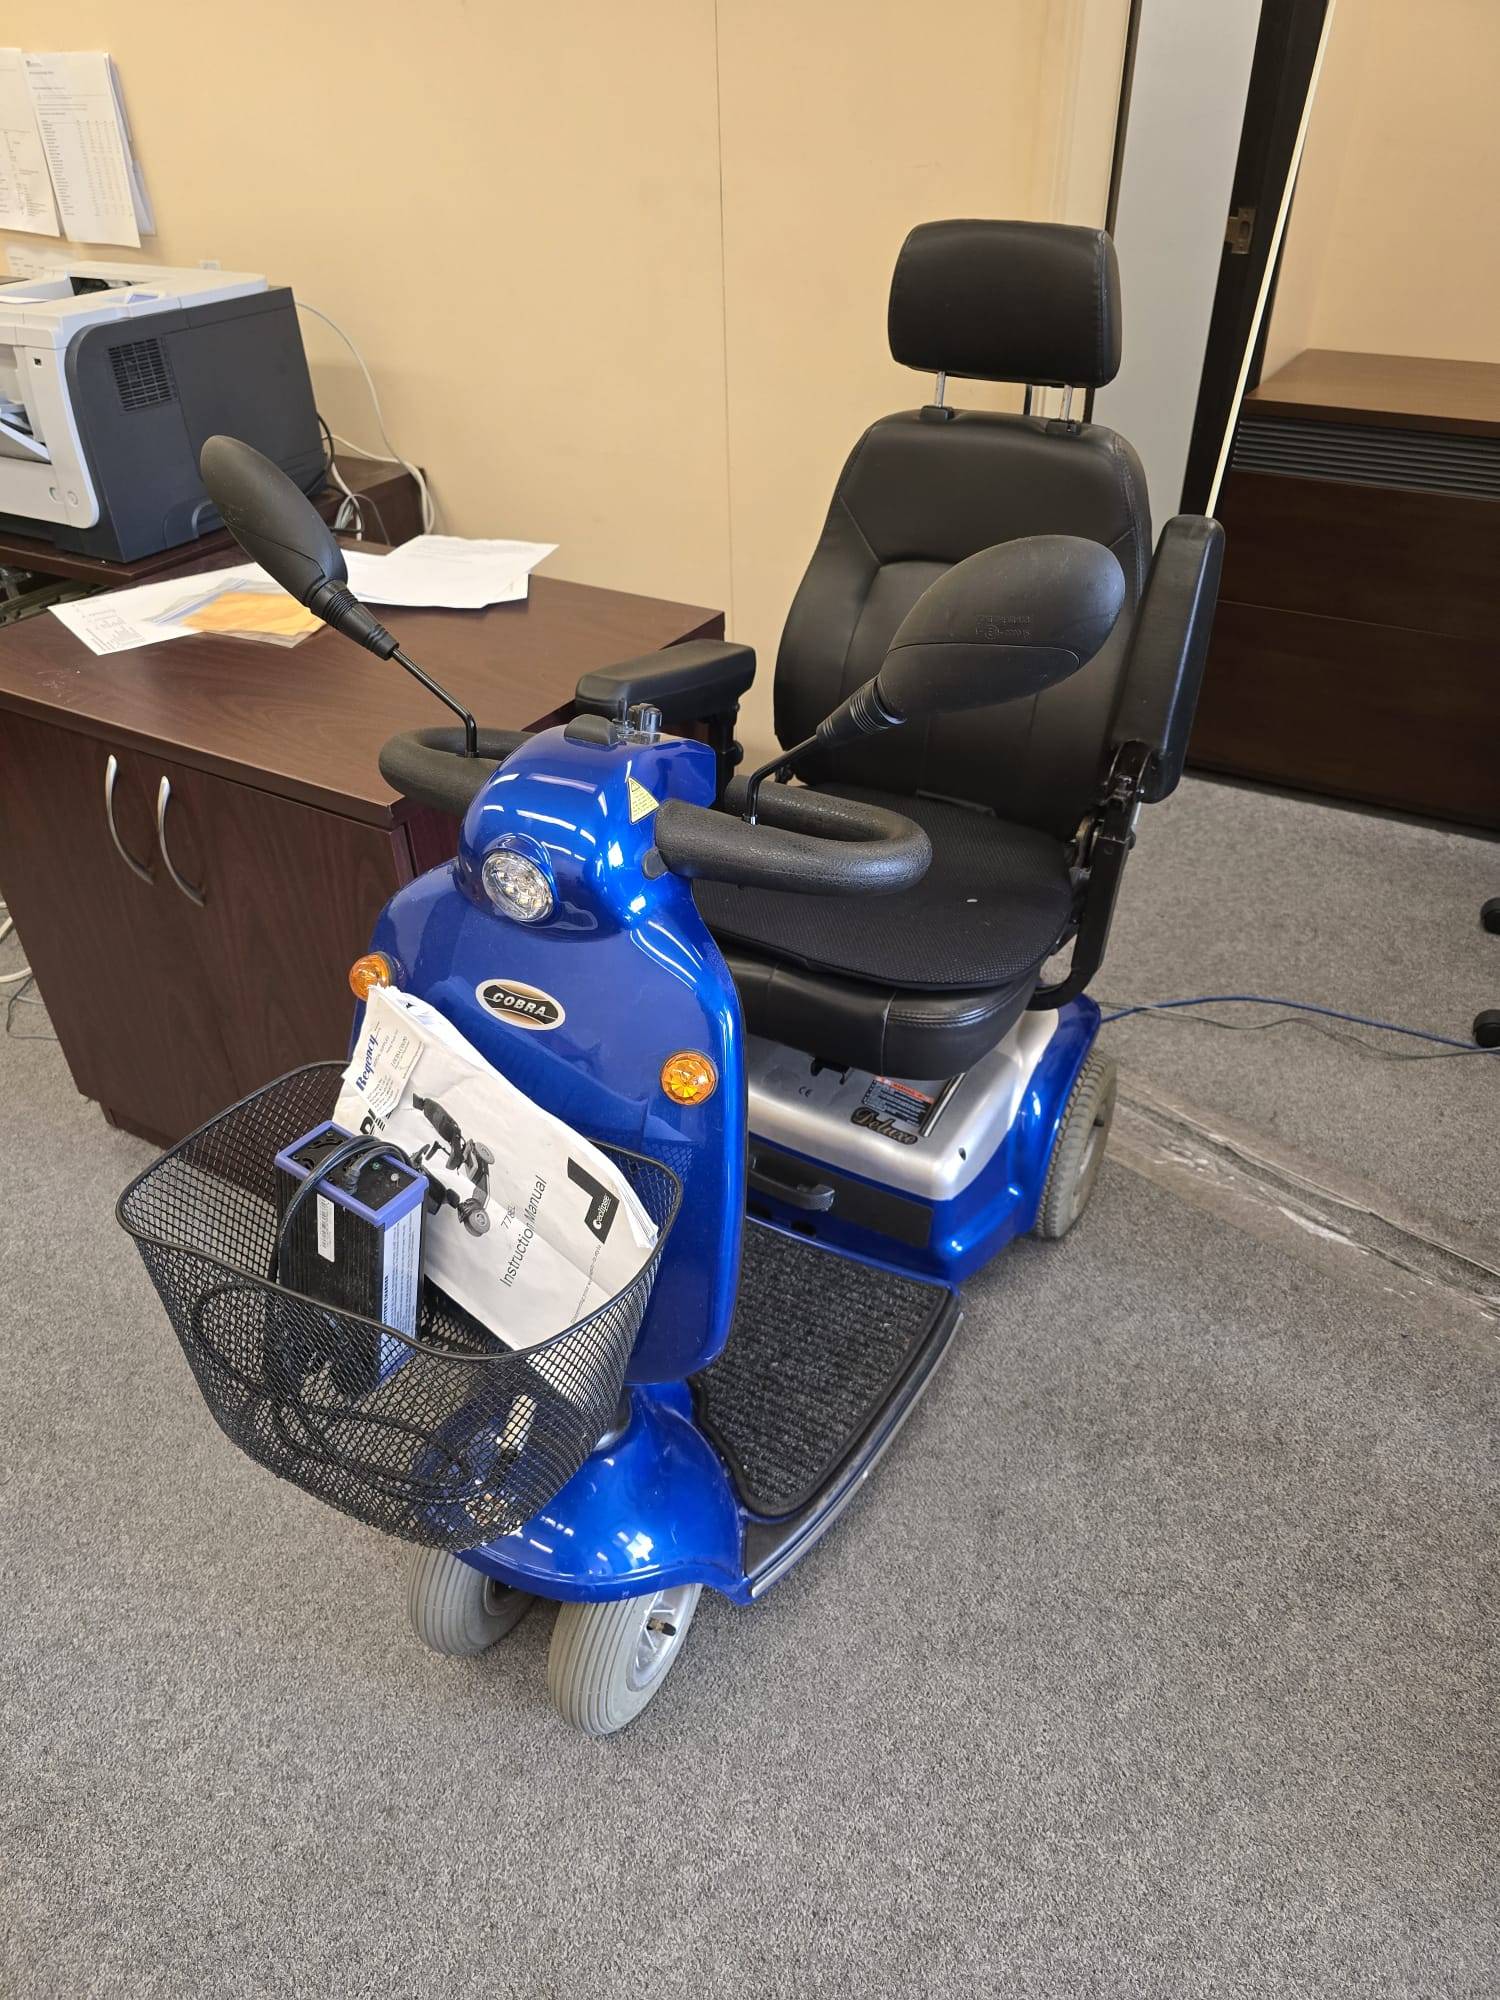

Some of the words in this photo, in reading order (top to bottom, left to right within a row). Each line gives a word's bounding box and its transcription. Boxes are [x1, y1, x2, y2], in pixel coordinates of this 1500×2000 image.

[492, 992, 547, 1017] COBRA
[355, 1034, 378, 1092] Regency
[852, 1108, 917, 1144] Deluxe
[499, 1221, 536, 1288] Instruction
[524, 1174, 548, 1224] Manual
